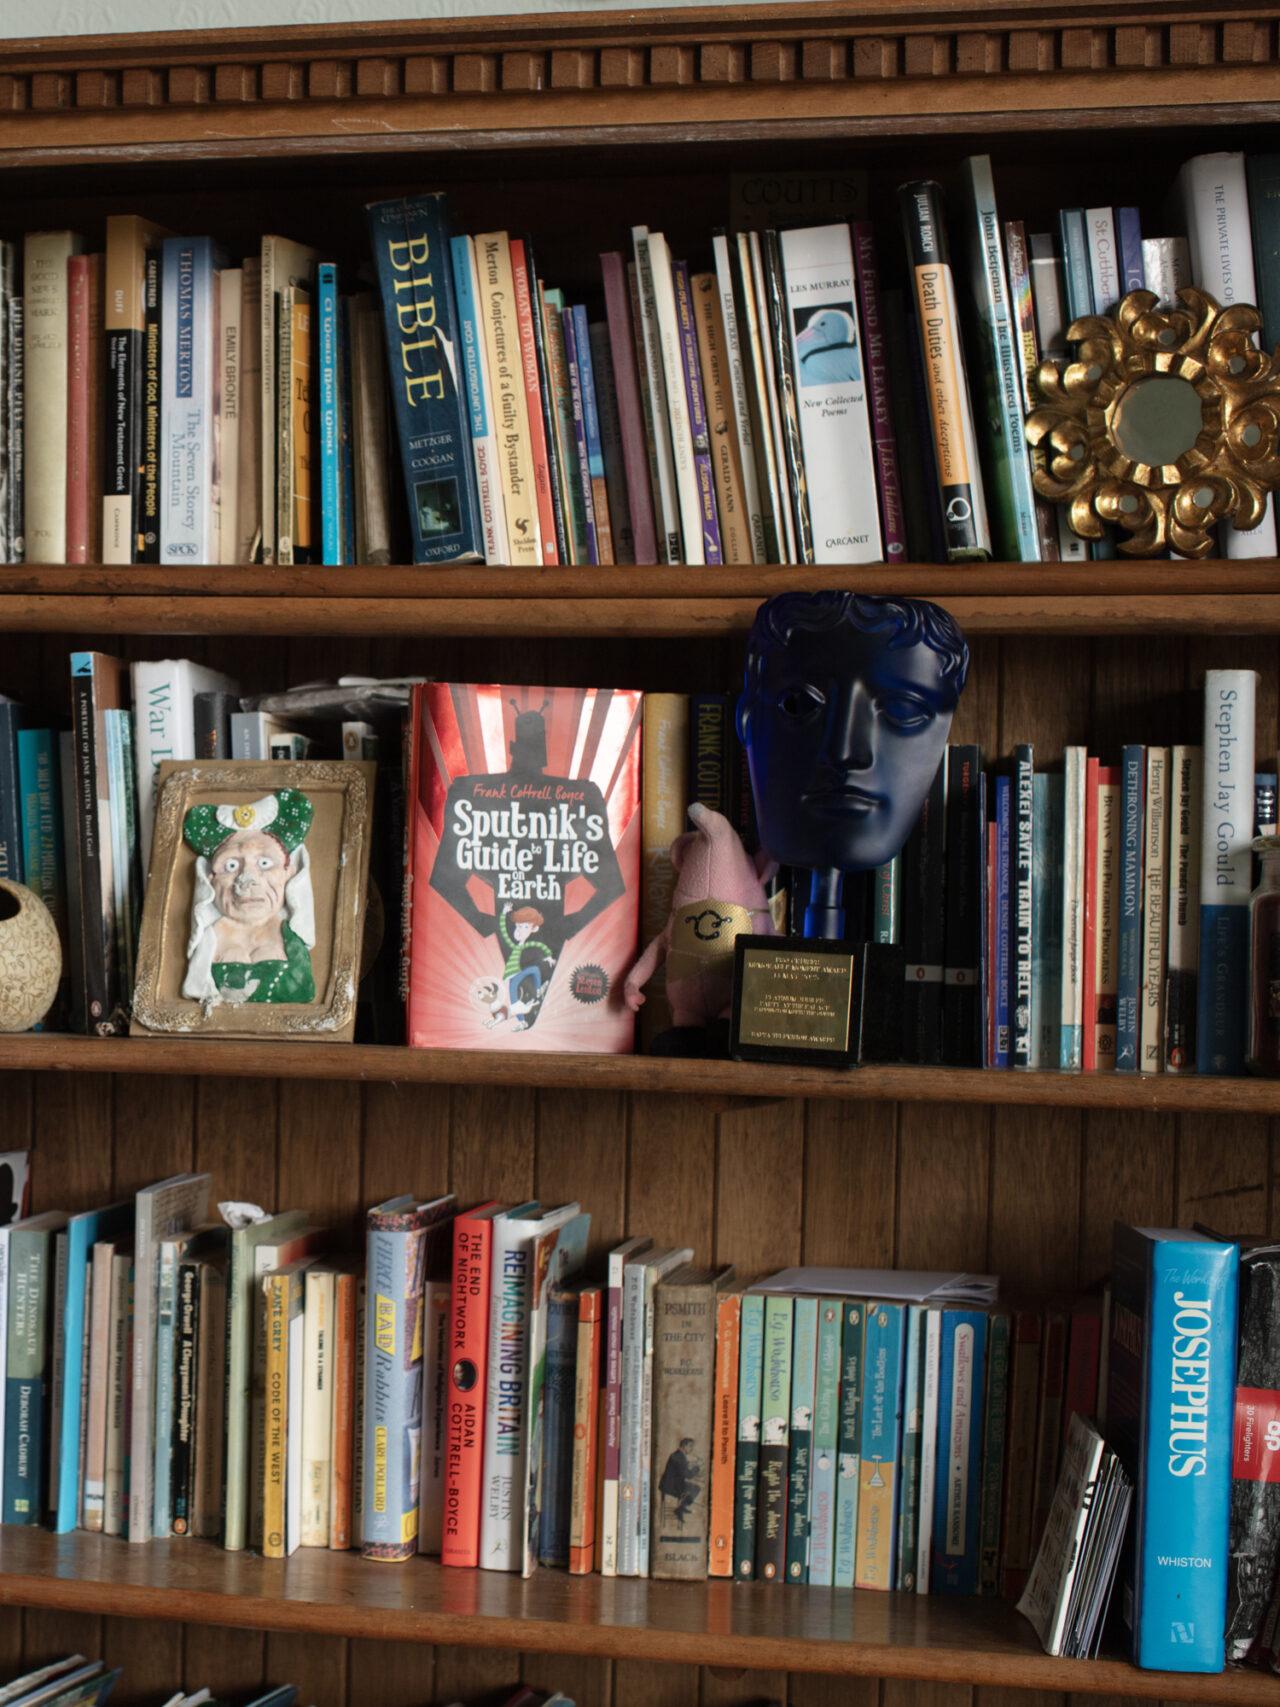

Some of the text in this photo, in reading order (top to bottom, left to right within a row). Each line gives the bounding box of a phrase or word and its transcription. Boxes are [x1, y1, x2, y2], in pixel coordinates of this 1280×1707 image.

[914, 194, 934, 252] JULIAN ROACH
[1216, 207, 1230, 251] PRIVATE
[810, 280, 850, 290] MURRAY
[981, 211, 1003, 304] John Betjeman
[1218, 254, 1233, 283] LIVES
[115, 290, 124, 313] DUFF
[178, 250, 192, 394] THOMAS MERTON
[388, 234, 445, 407] BIBLE
[1222, 286, 1234, 302] OF
[224, 327, 236, 361] EMILY
[515, 266, 538, 392] WOMAN TO WOMAN
[485, 242, 524, 495] Merton Conjectures of a Guilty Bystander
[920, 272, 954, 477] Death Duties and other deceptions
[996, 318, 1024, 453] The Illustrated Poems
[116, 337, 126, 490] The Elements of New Testament Greek
[145, 324, 158, 516] Ministers of God, Ministers of the People
[171, 433, 185, 507] Mountain
[183, 410, 201, 530] The Seven Storey
[720, 445, 735, 513] GERALD VANN
[825, 534, 869, 548] CARCANET
[80, 700, 88, 740] PORTRAIT
[147, 682, 173, 738] War
[82, 743, 90, 753] OF
[82, 755, 90, 776] JANE
[83, 778, 92, 810] AUSTEN
[473, 782, 585, 805] Frank Cottrell Boyce
[1018, 761, 1031, 869] ALEXEI SAYLE
[1149, 759, 1164, 858] Henry Williamson
[1214, 689, 1236, 887] Stephen Jay Gould
[85, 815, 94, 857] David Cecil
[453, 799, 604, 846] Sputnik's
[455, 837, 599, 874] Guide to Life
[1124, 760, 1138, 916] DETHRONING MAMMON
[498, 873, 561, 900] Earth
[512, 870, 525, 882] on
[1017, 880, 1030, 998] TRAIN TO HELL
[1147, 866, 1161, 1007] THE BEAUTIFUL YEARS
[454, 1232, 470, 1349] OF NIGHTWORK
[469, 1233, 482, 1296] THE END
[15, 1273, 28, 1336] HUNTERS
[26, 1252, 40, 1355] THE DINOSAUR
[272, 1286, 282, 1352] ZANE GREY
[378, 1302, 394, 1348] BAD
[496, 1250, 527, 1455] REIMAGINING BRITAIN
[1169, 1292, 1212, 1476] JOSEPHUS
[375, 1354, 392, 1422] Rabbits
[17, 1386, 31, 1478] DEBORAH CADBURY
[271, 1372, 281, 1484] CODE OF THE WEST
[463, 1403, 476, 1448] AIDAN
[1242, 1404, 1255, 1462] 30 Firelighters
[374, 1427, 386, 1512] CLARE POLLARD
[447, 1403, 463, 1536] COTTRELL-BOYCE
[1157, 1555, 1212, 1568] WHISTON
